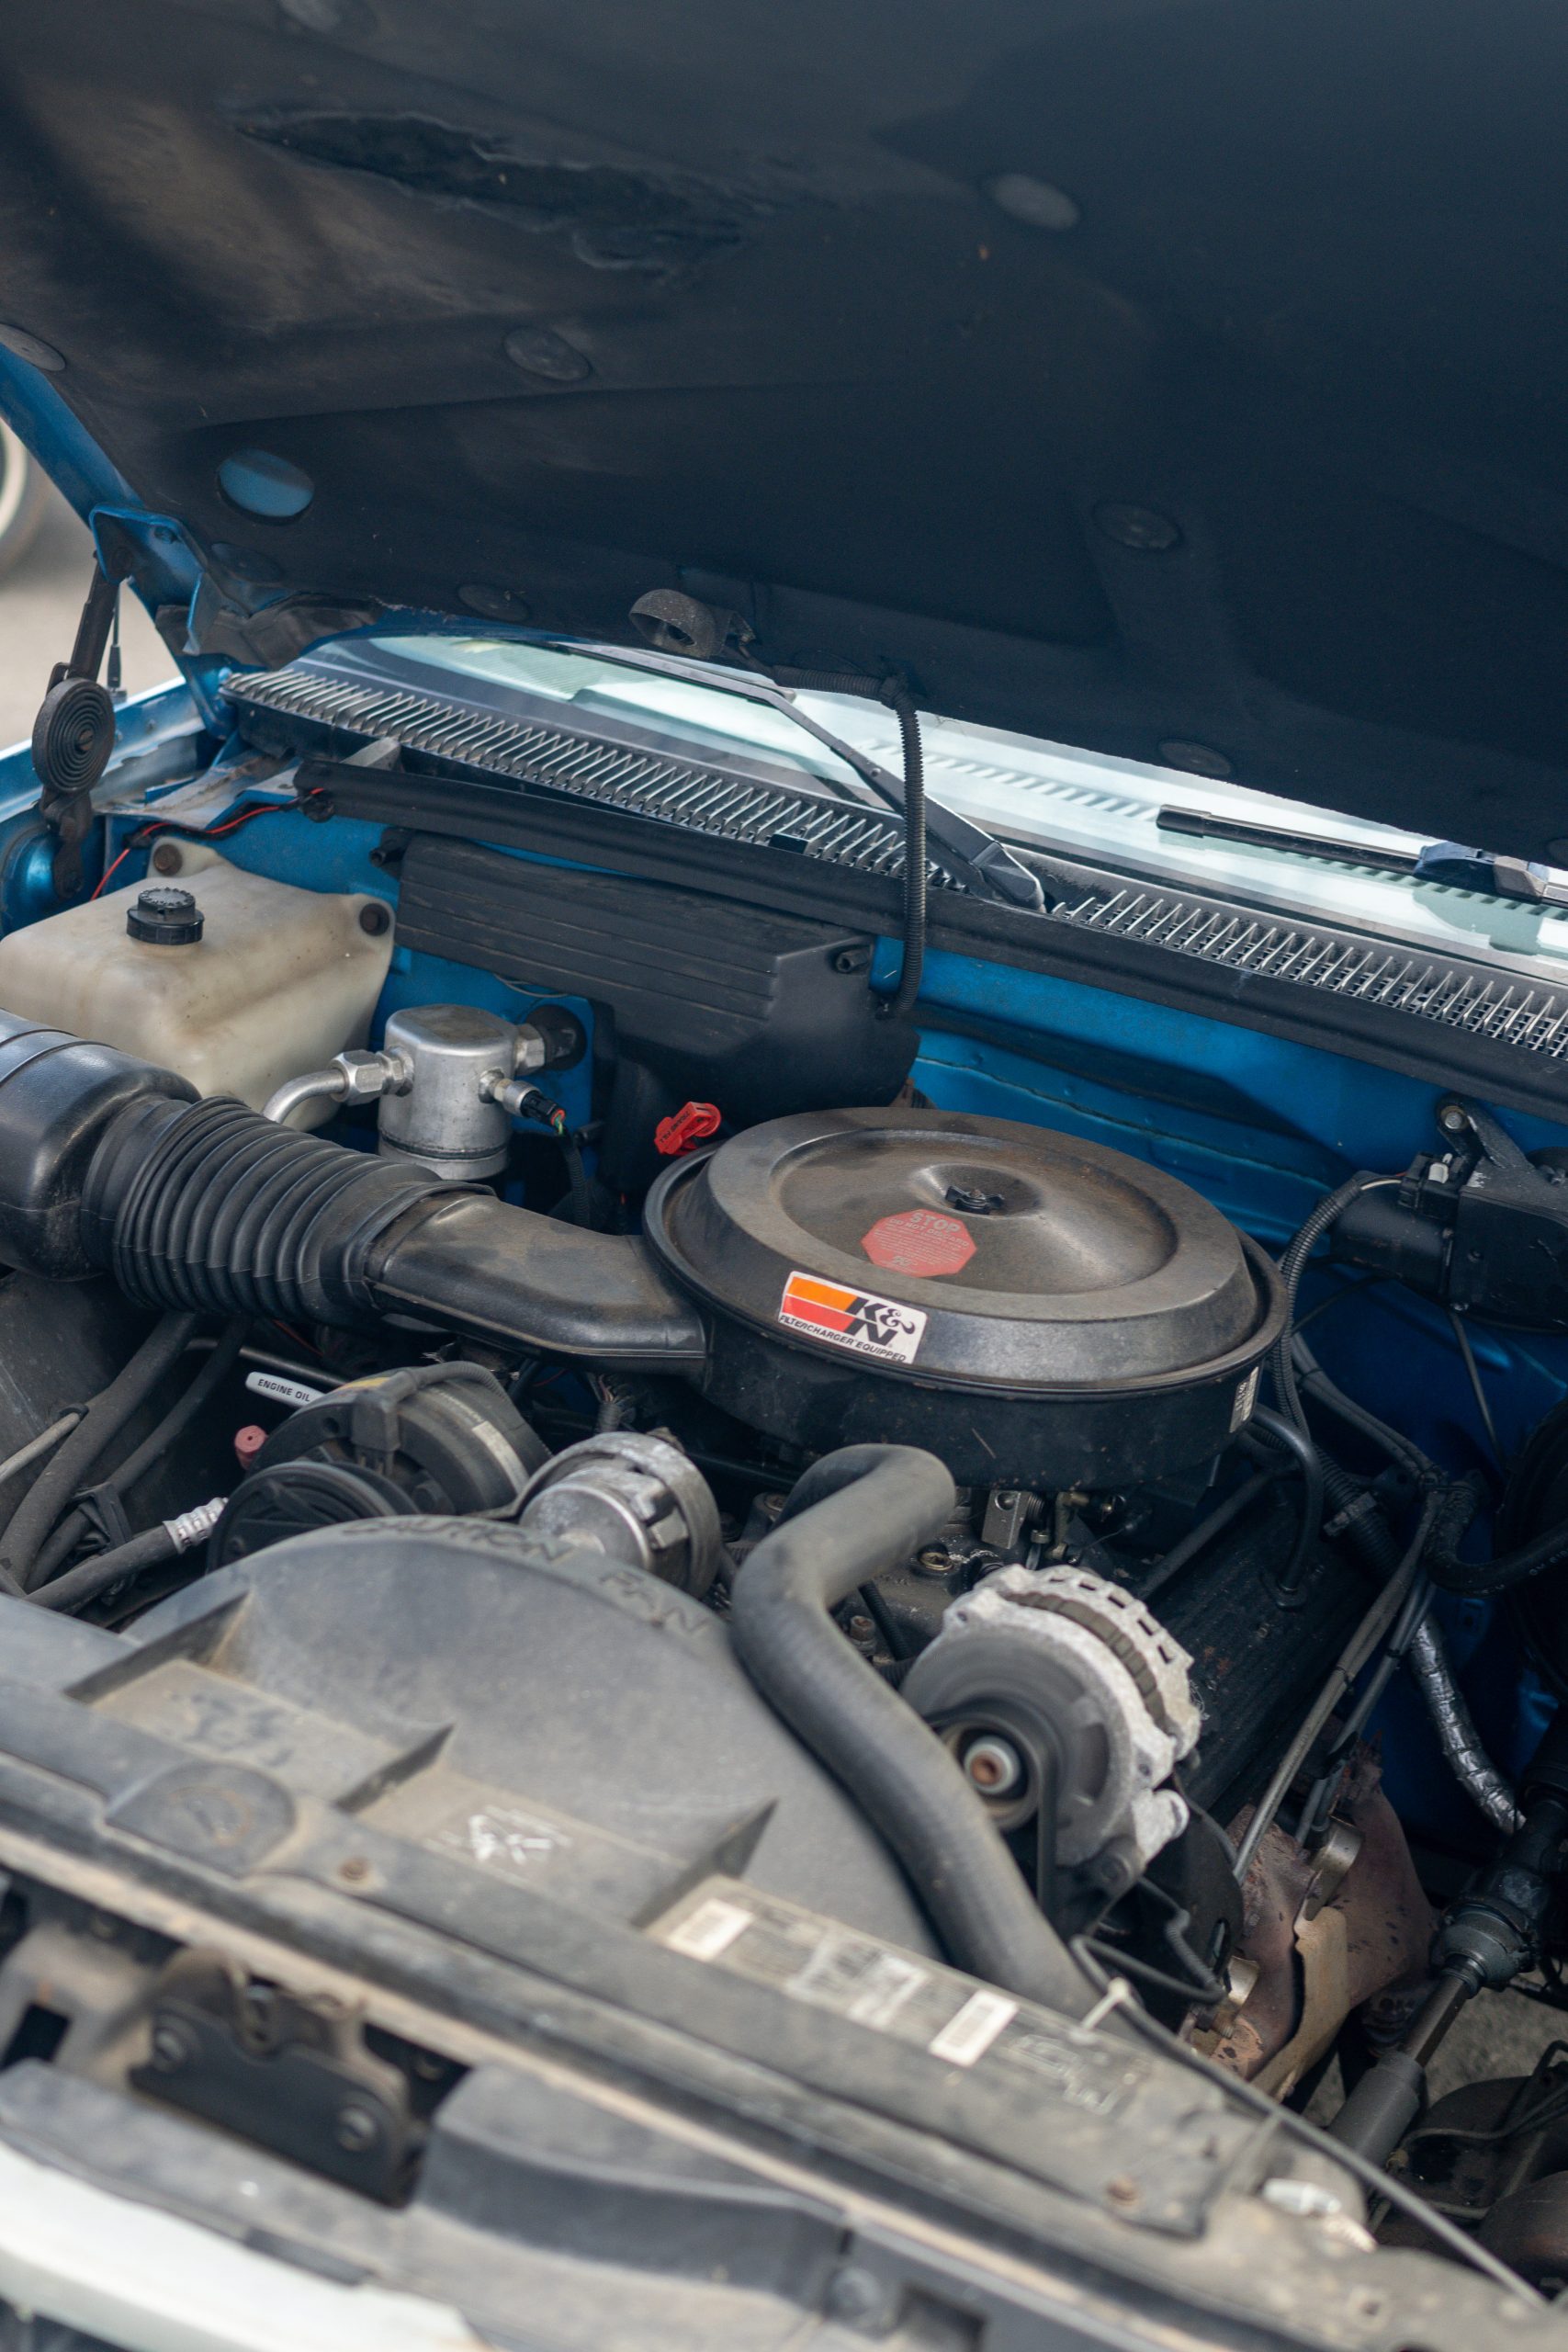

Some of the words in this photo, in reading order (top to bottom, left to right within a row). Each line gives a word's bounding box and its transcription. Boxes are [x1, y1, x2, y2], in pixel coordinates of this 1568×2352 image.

[905, 1221, 927, 1231] NOT
[910, 1212, 961, 1233] STOP
[855, 1341, 908, 1363] EQUIPPED
[257, 1378, 293, 1396] ENGINE
[295, 1390, 310, 1402] OIL
